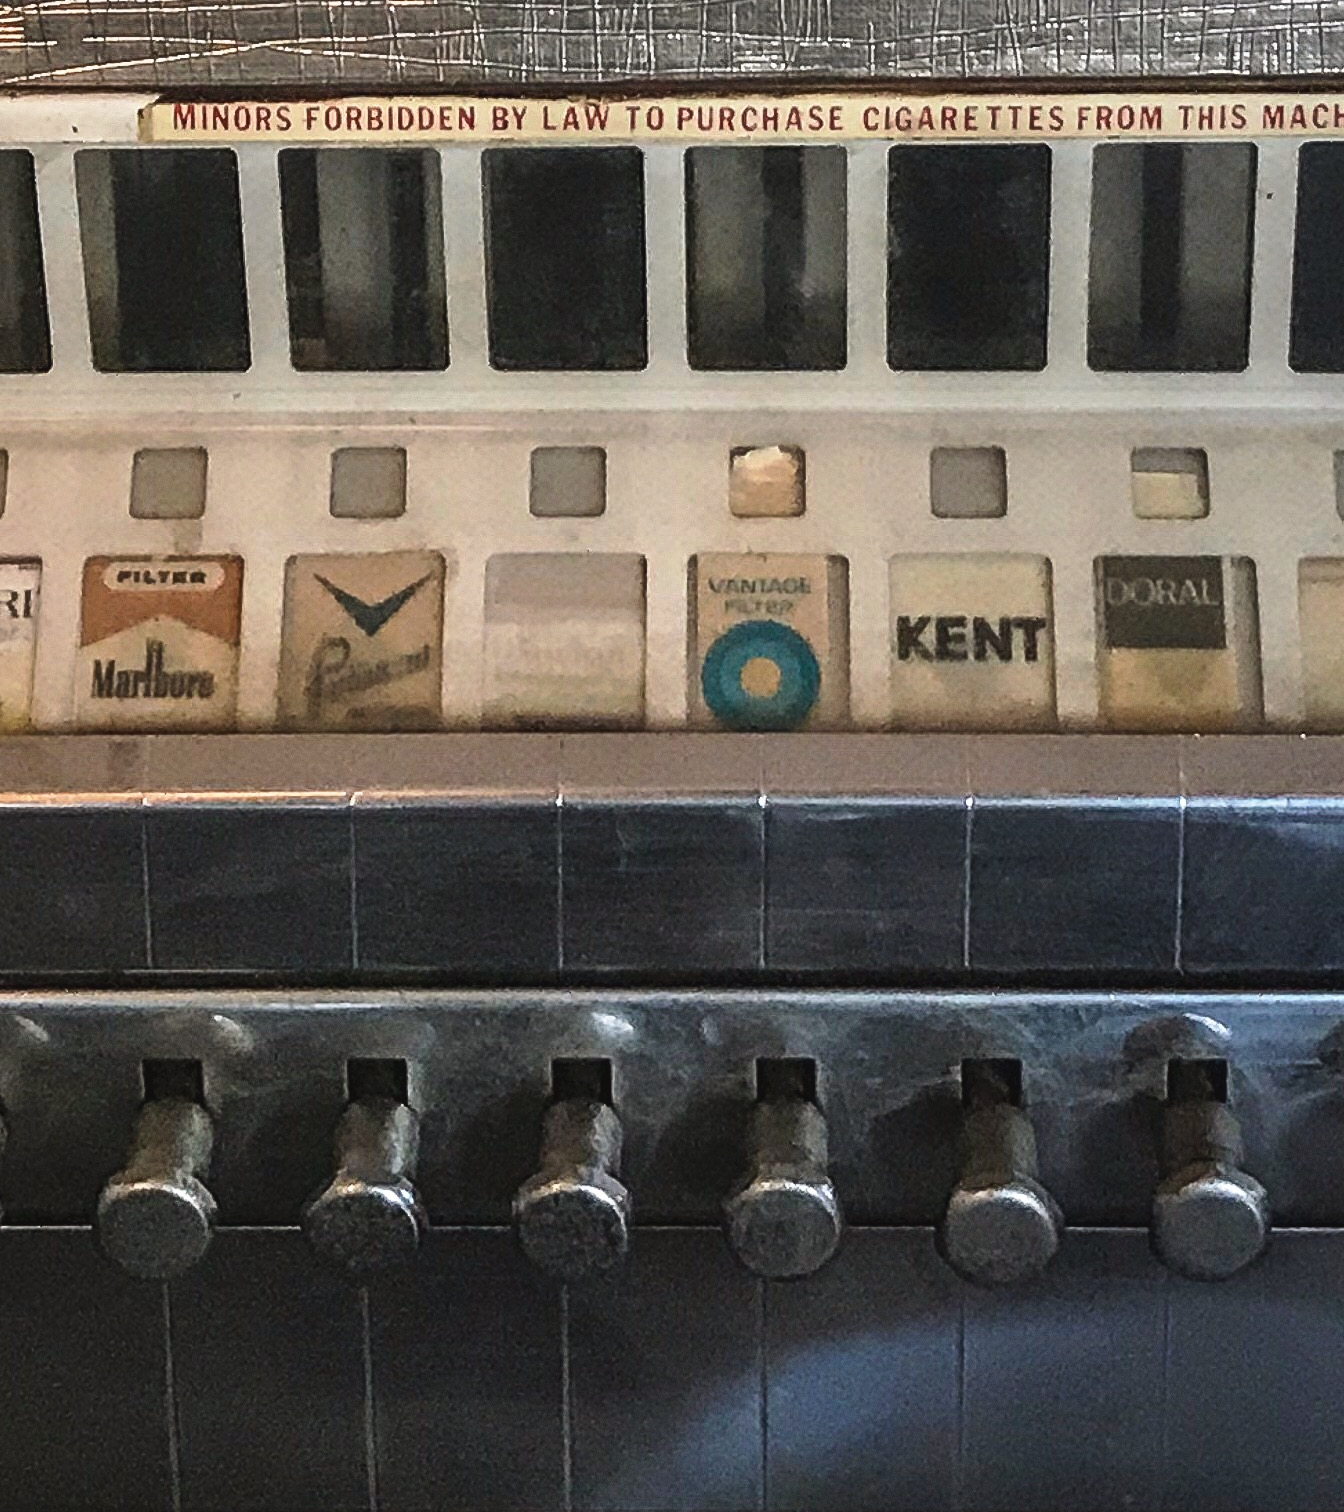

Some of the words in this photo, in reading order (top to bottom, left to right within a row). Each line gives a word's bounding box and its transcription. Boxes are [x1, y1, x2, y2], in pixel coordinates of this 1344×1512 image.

[173, 104, 292, 132] MINORS
[306, 104, 475, 132] FORBIDDEN
[492, 104, 524, 132] BY
[543, 104, 609, 132] LAW
[626, 104, 664, 131] TO
[677, 104, 844, 131] PURCHASE
[862, 104, 1065, 131] CIGARETTES
[1077, 105, 1163, 131] FROM
[1179, 104, 1247, 130] THIS
[116, 569, 207, 586] FILTER
[708, 576, 812, 594] VANTAGE
[1105, 576, 1222, 607] DORAL
[896, 614, 1048, 663] KENT
[90, 637, 216, 700] Marlboro
